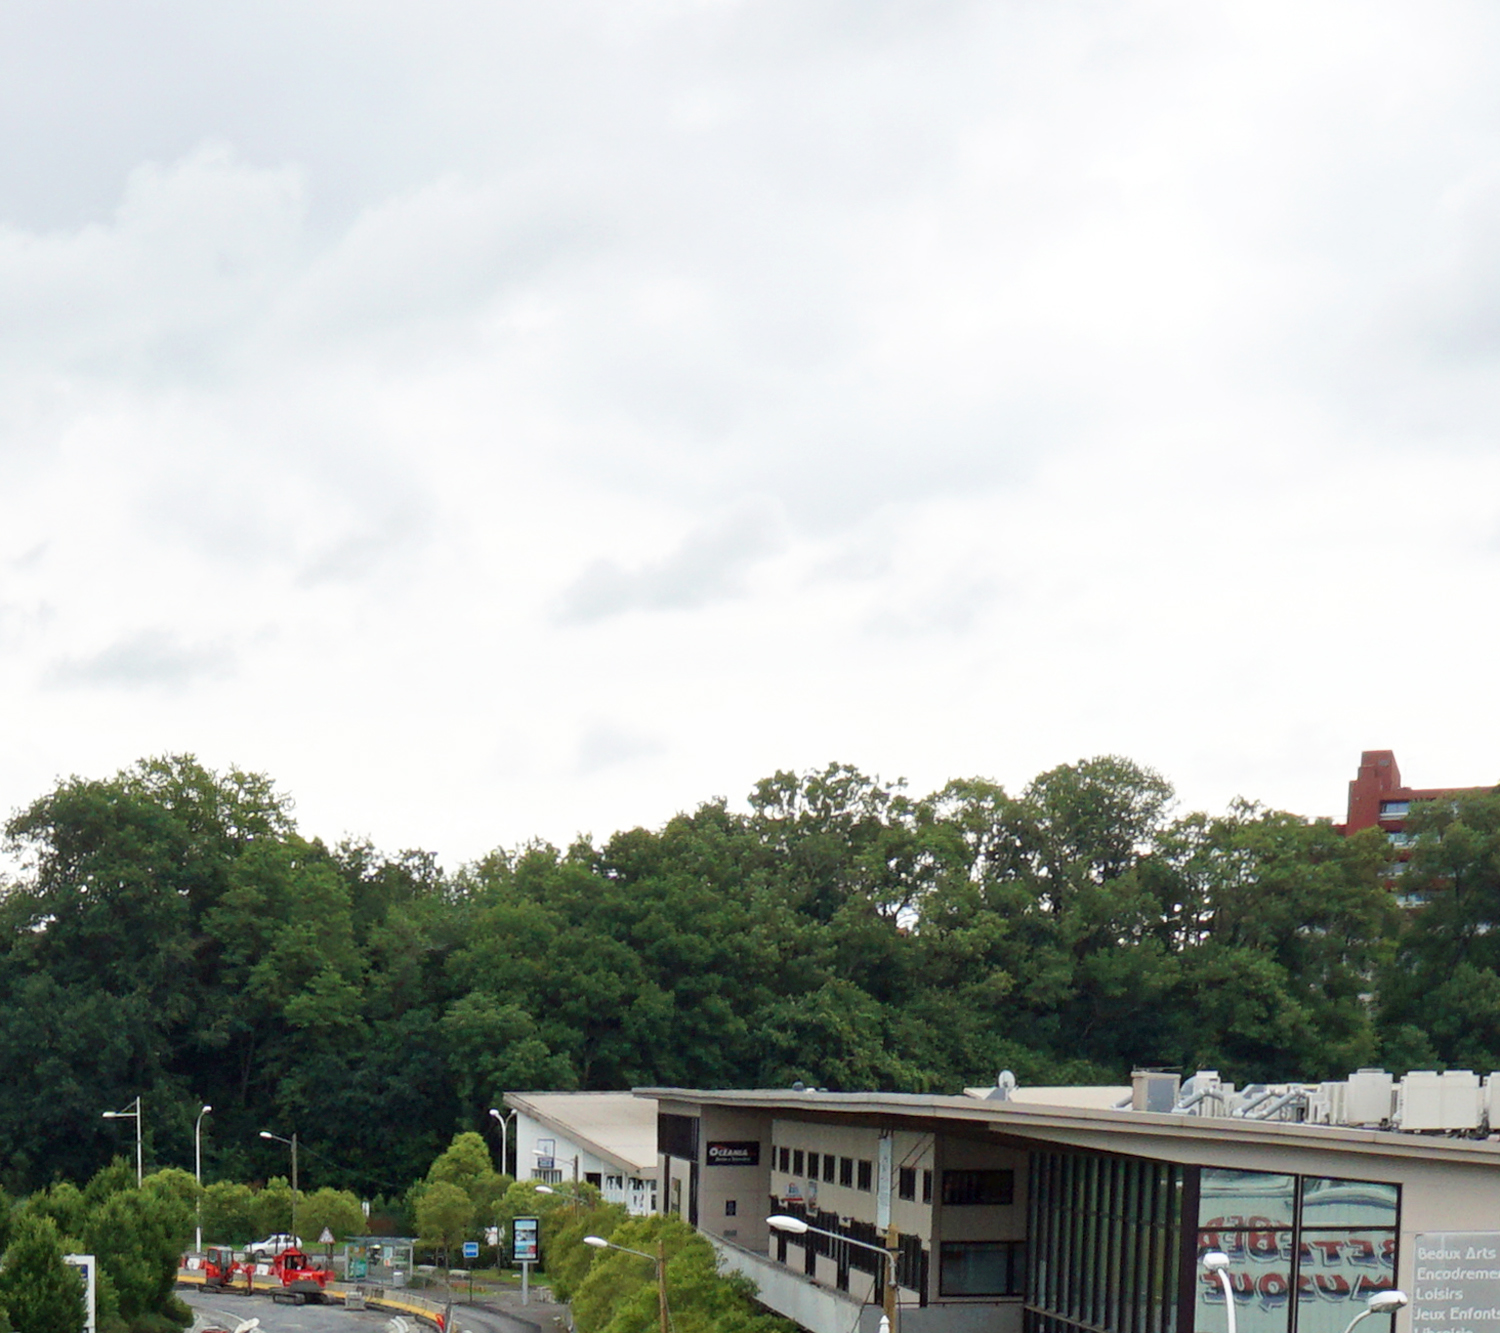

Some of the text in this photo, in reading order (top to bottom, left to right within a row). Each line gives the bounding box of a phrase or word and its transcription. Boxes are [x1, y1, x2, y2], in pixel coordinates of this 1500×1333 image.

[1418, 1246, 1497, 1261] Beaux Arts
[1415, 1287, 1464, 1301] Loisirs
[1414, 1307, 1446, 1321] Jeux
